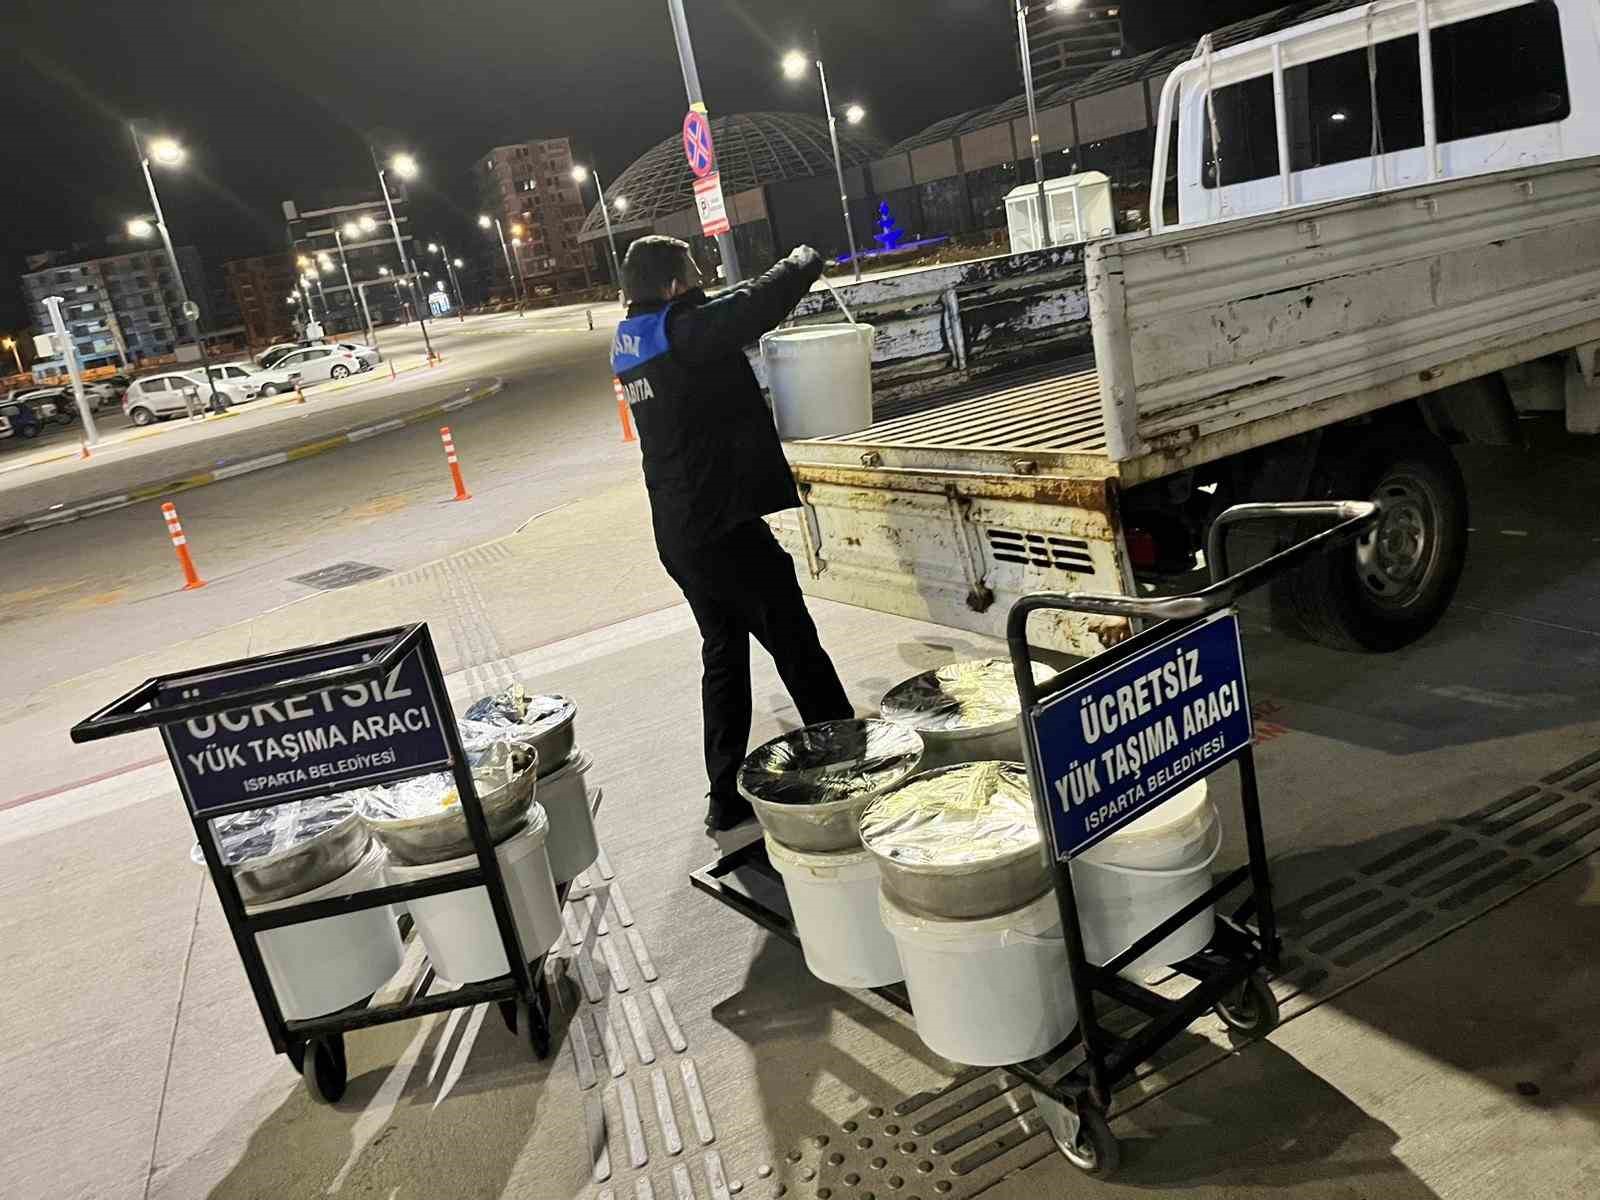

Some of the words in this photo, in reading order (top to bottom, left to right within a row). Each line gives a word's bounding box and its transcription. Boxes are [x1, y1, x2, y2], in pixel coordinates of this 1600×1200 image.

[187, 744, 247, 776] YÜK
[248, 724, 347, 762] TAŞIMA
[351, 705, 431, 744] ARACI
[1080, 647, 1203, 744] ÜCRETSİZ
[243, 771, 307, 793] ISPARTA
[308, 748, 397, 780] BELEDİYESİ
[1055, 760, 1102, 813] YÜK
[1101, 715, 1179, 784] TAŞIMA
[1183, 680, 1240, 740] ARACI
[1084, 786, 1146, 833] ISPARTA
[1148, 731, 1226, 793] BELEDİYESİ
